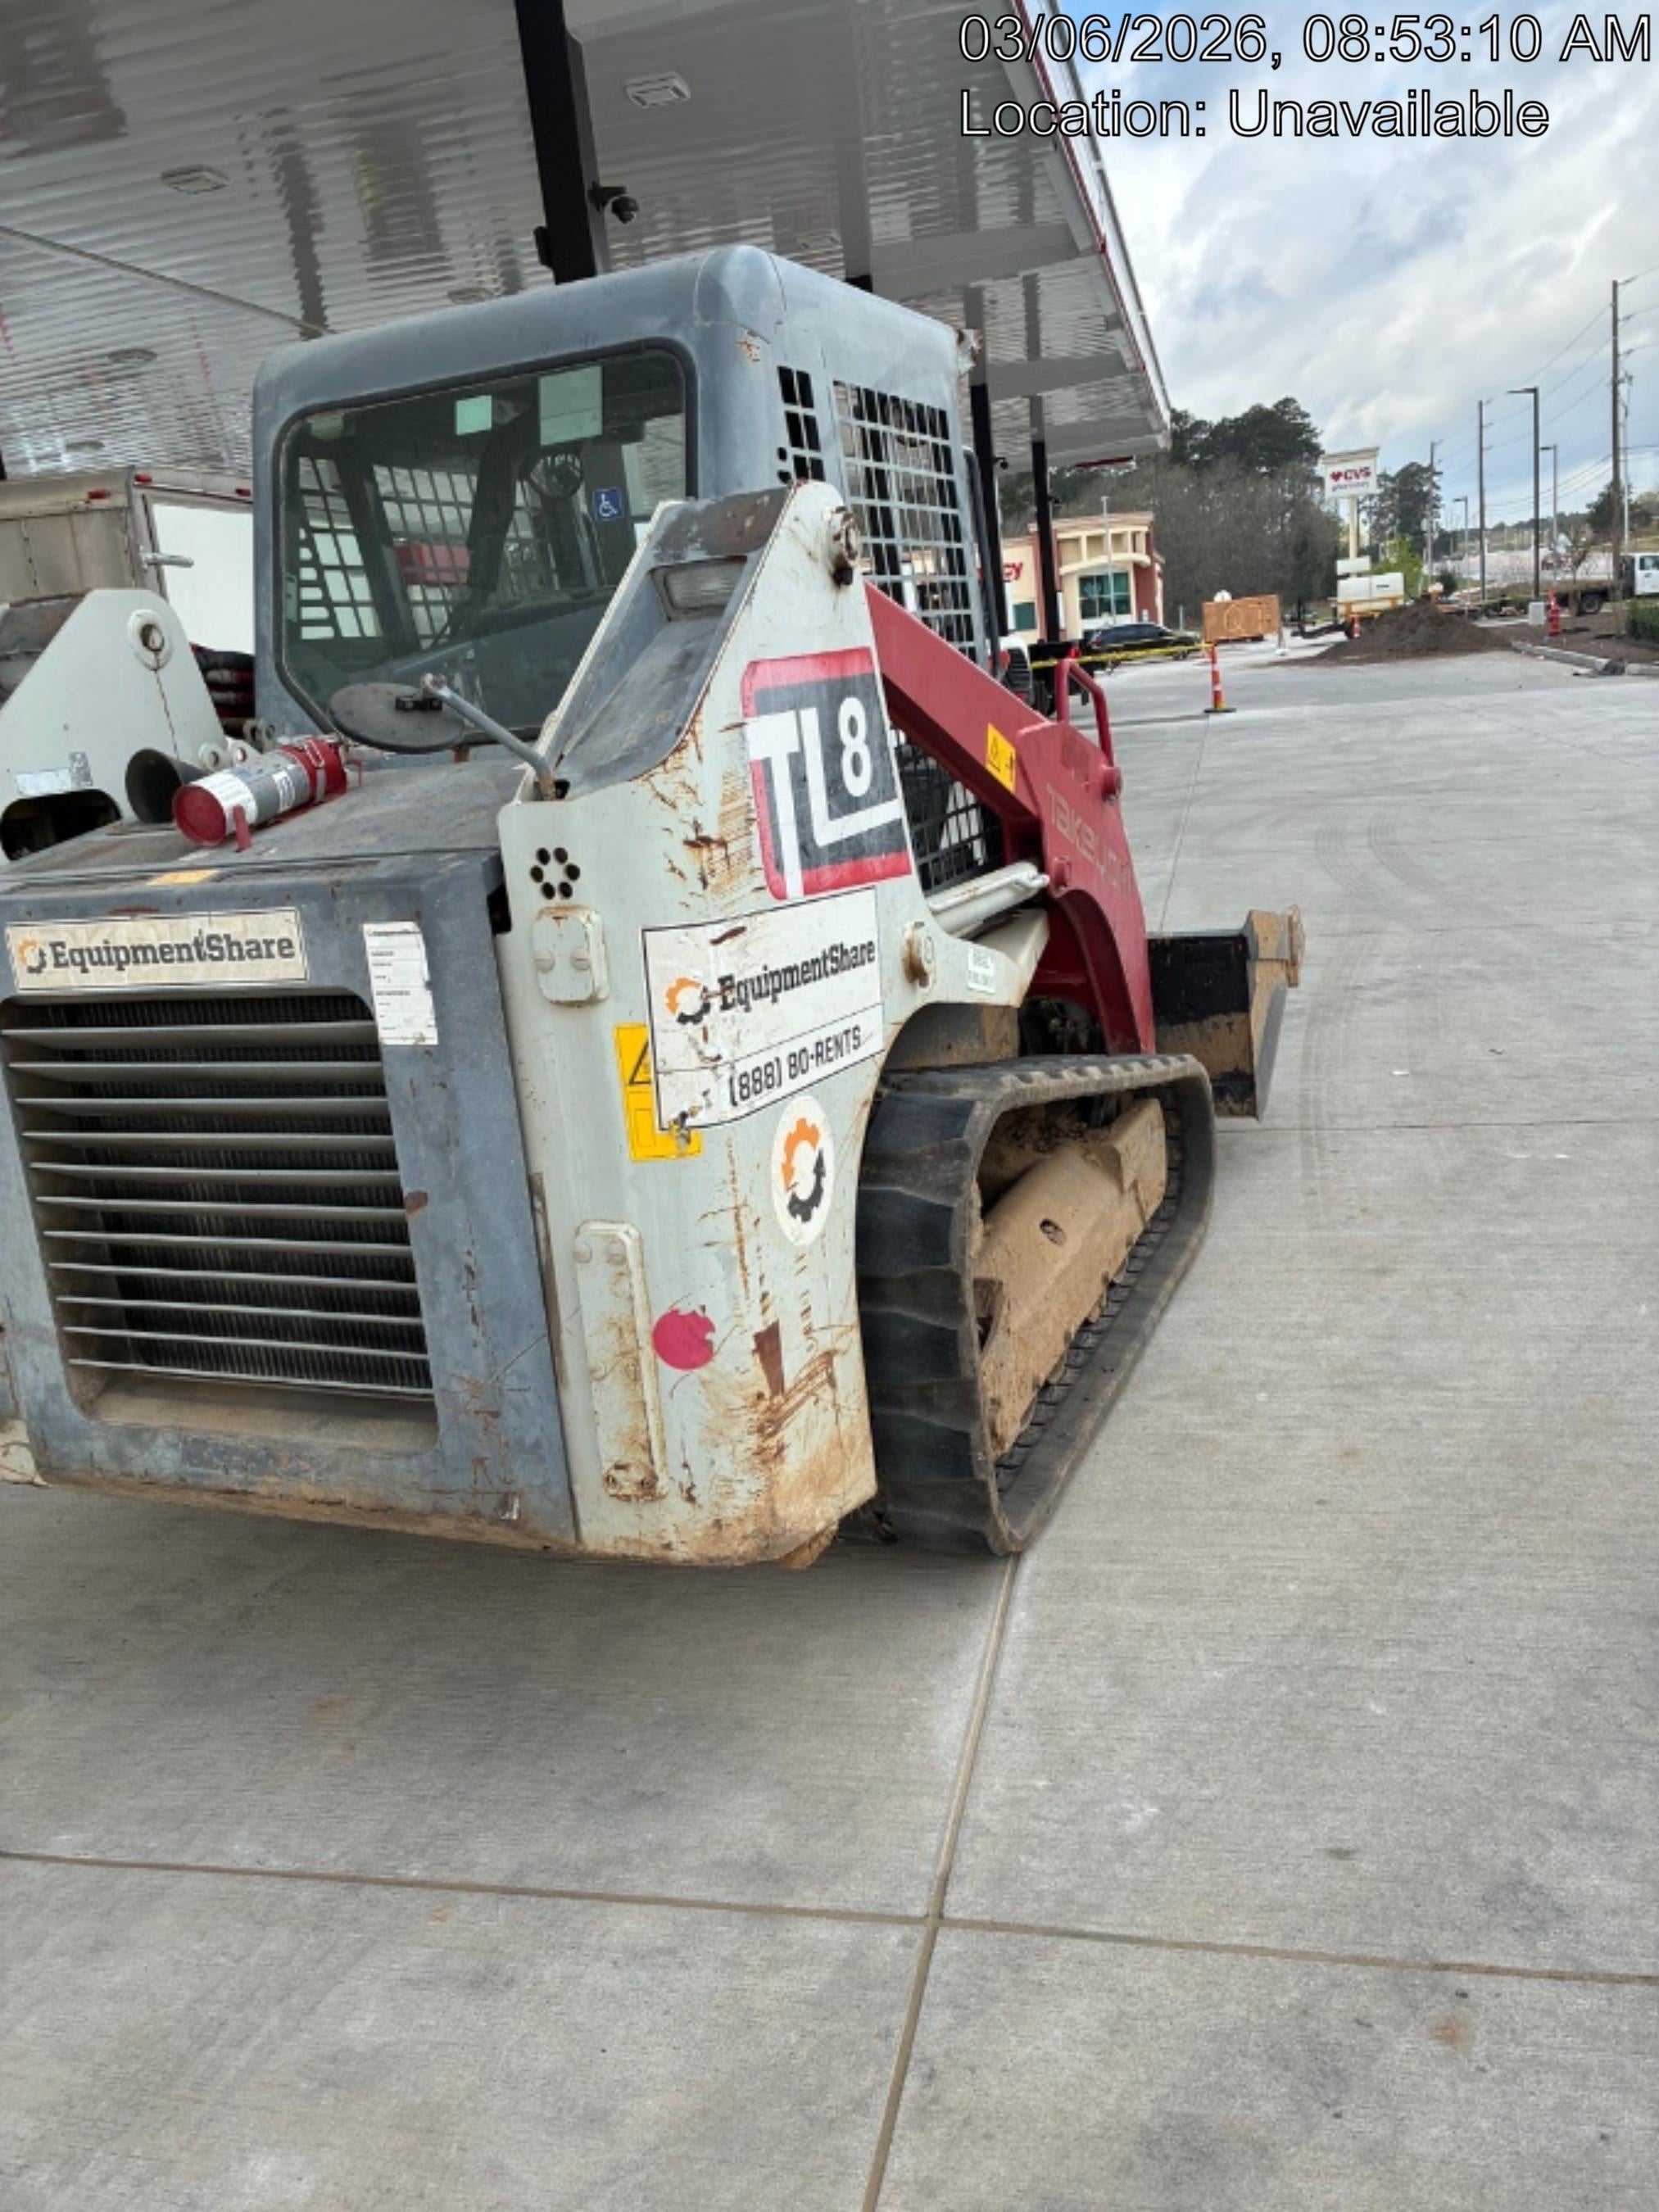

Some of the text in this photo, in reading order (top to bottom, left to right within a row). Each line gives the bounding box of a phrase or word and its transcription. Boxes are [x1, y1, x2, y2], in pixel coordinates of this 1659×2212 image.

[1344, 467, 1371, 480] CVS
[746, 696, 902, 900] TL8
[49, 927, 296, 974] EquipmentShare
[717, 940, 877, 1013] EquipmentShare
[728, 1056, 782, 1107] (888)
